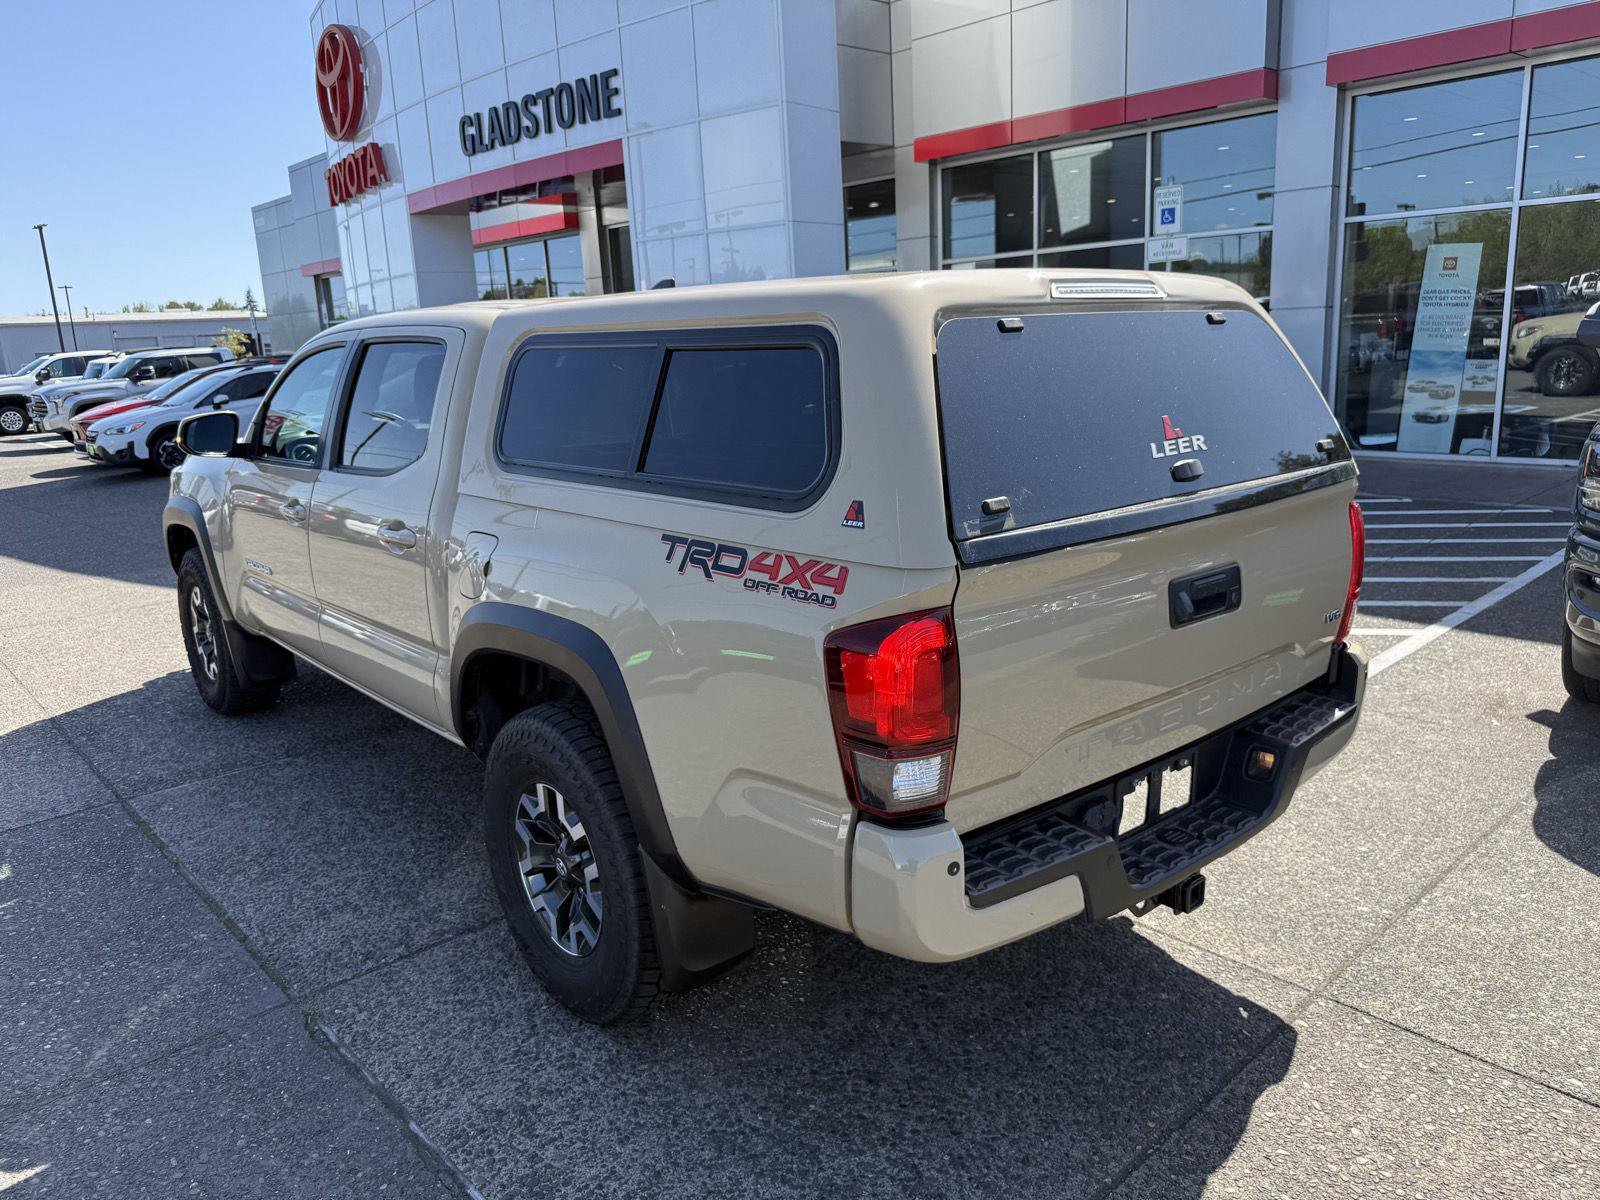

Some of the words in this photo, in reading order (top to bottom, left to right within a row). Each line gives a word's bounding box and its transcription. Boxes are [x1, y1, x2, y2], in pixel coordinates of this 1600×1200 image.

[459, 68, 623, 157] GLADSTONE
[325, 142, 389, 206] TOYOTA
[1150, 434, 1208, 459] LEER
[842, 519, 865, 528] LEER
[661, 533, 750, 583] TRD
[743, 577, 780, 594] OFF
[781, 585, 838, 609] ROAD
[1325, 607, 1341, 624] V6
